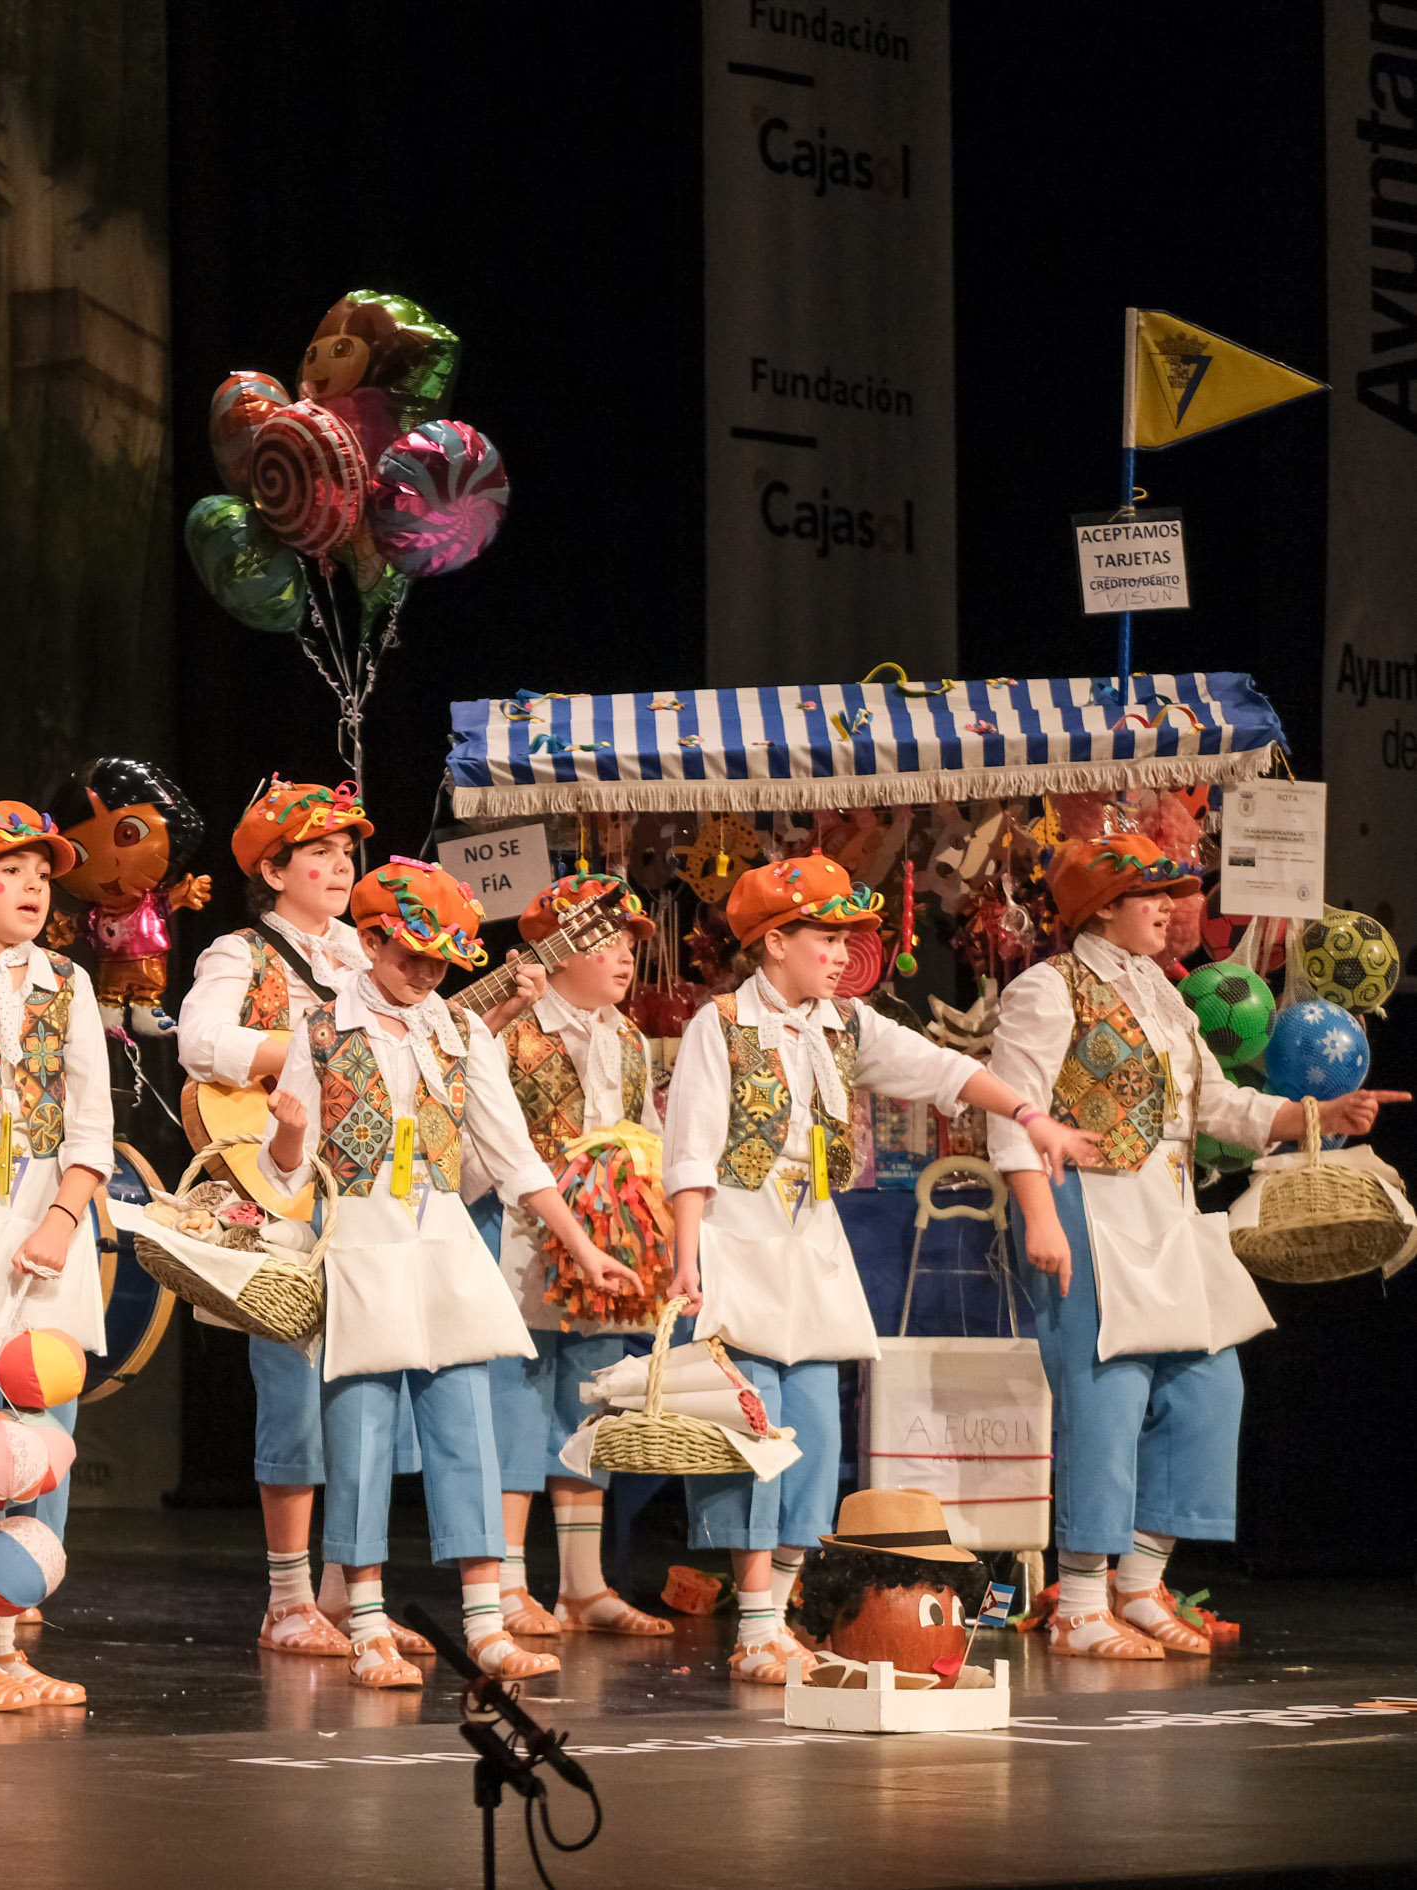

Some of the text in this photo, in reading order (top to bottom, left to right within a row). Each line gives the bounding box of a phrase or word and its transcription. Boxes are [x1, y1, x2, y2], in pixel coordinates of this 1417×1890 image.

[750, 0, 910, 62] Fundación
[759, 117, 911, 199] Cajasol
[750, 356, 914, 417] Fundación
[759, 481, 915, 557] Cajasol
[1080, 523, 1180, 544] ACEPTAMOS
[1093, 550, 1172, 569] TARJETAS
[464, 839, 521, 863] NO SE
[903, 1415, 932, 1446] A
